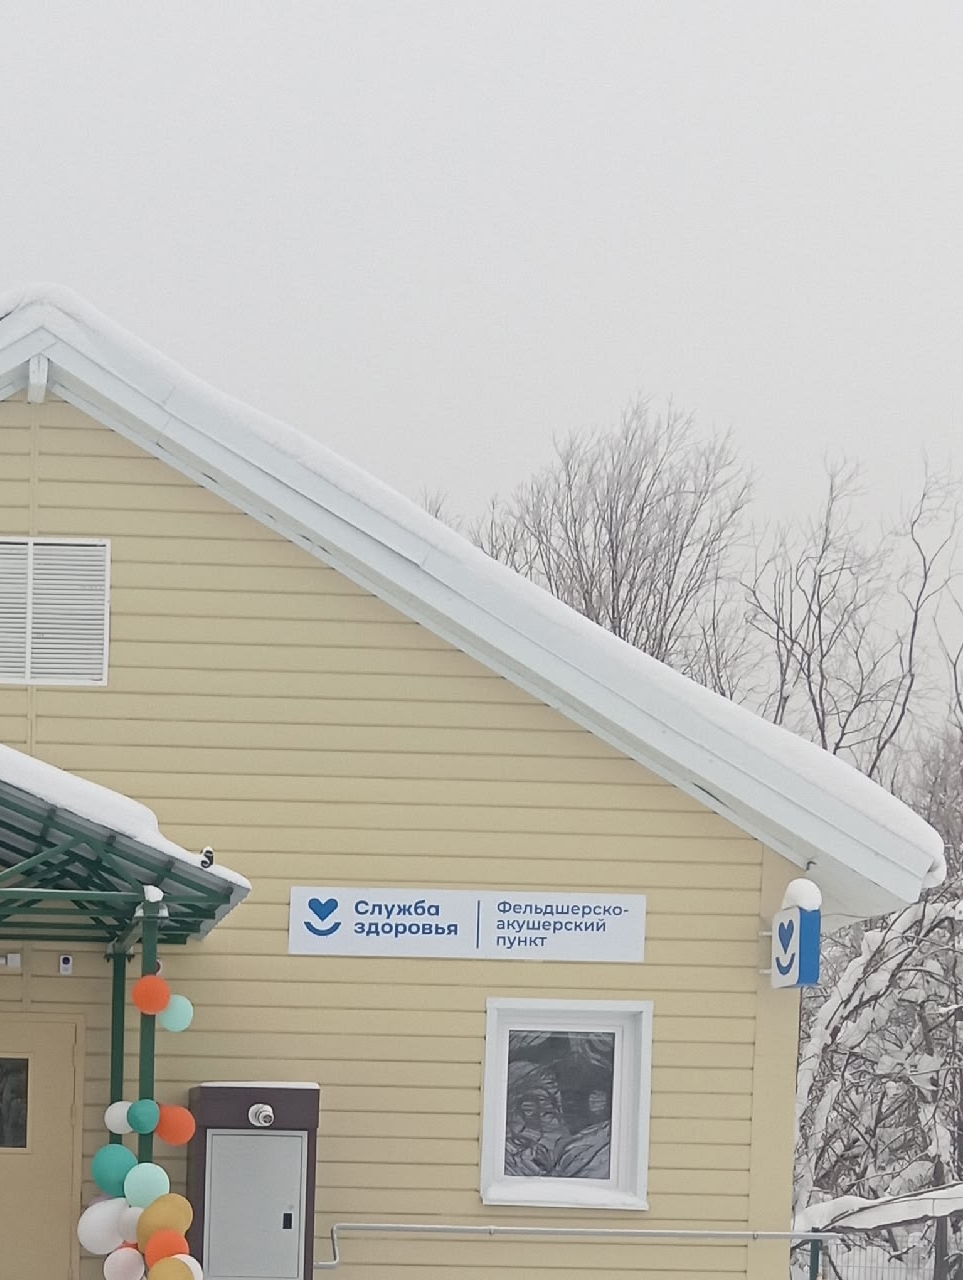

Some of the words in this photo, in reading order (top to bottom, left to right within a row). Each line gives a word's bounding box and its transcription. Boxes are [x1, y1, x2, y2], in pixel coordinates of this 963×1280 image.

[354, 900, 440, 920] Служба
[497, 900, 629, 918] Фельдшерско-
[354, 922, 458, 938] здоровья
[496, 918, 606, 934] акушерский
[496, 935, 547, 950] пункт
